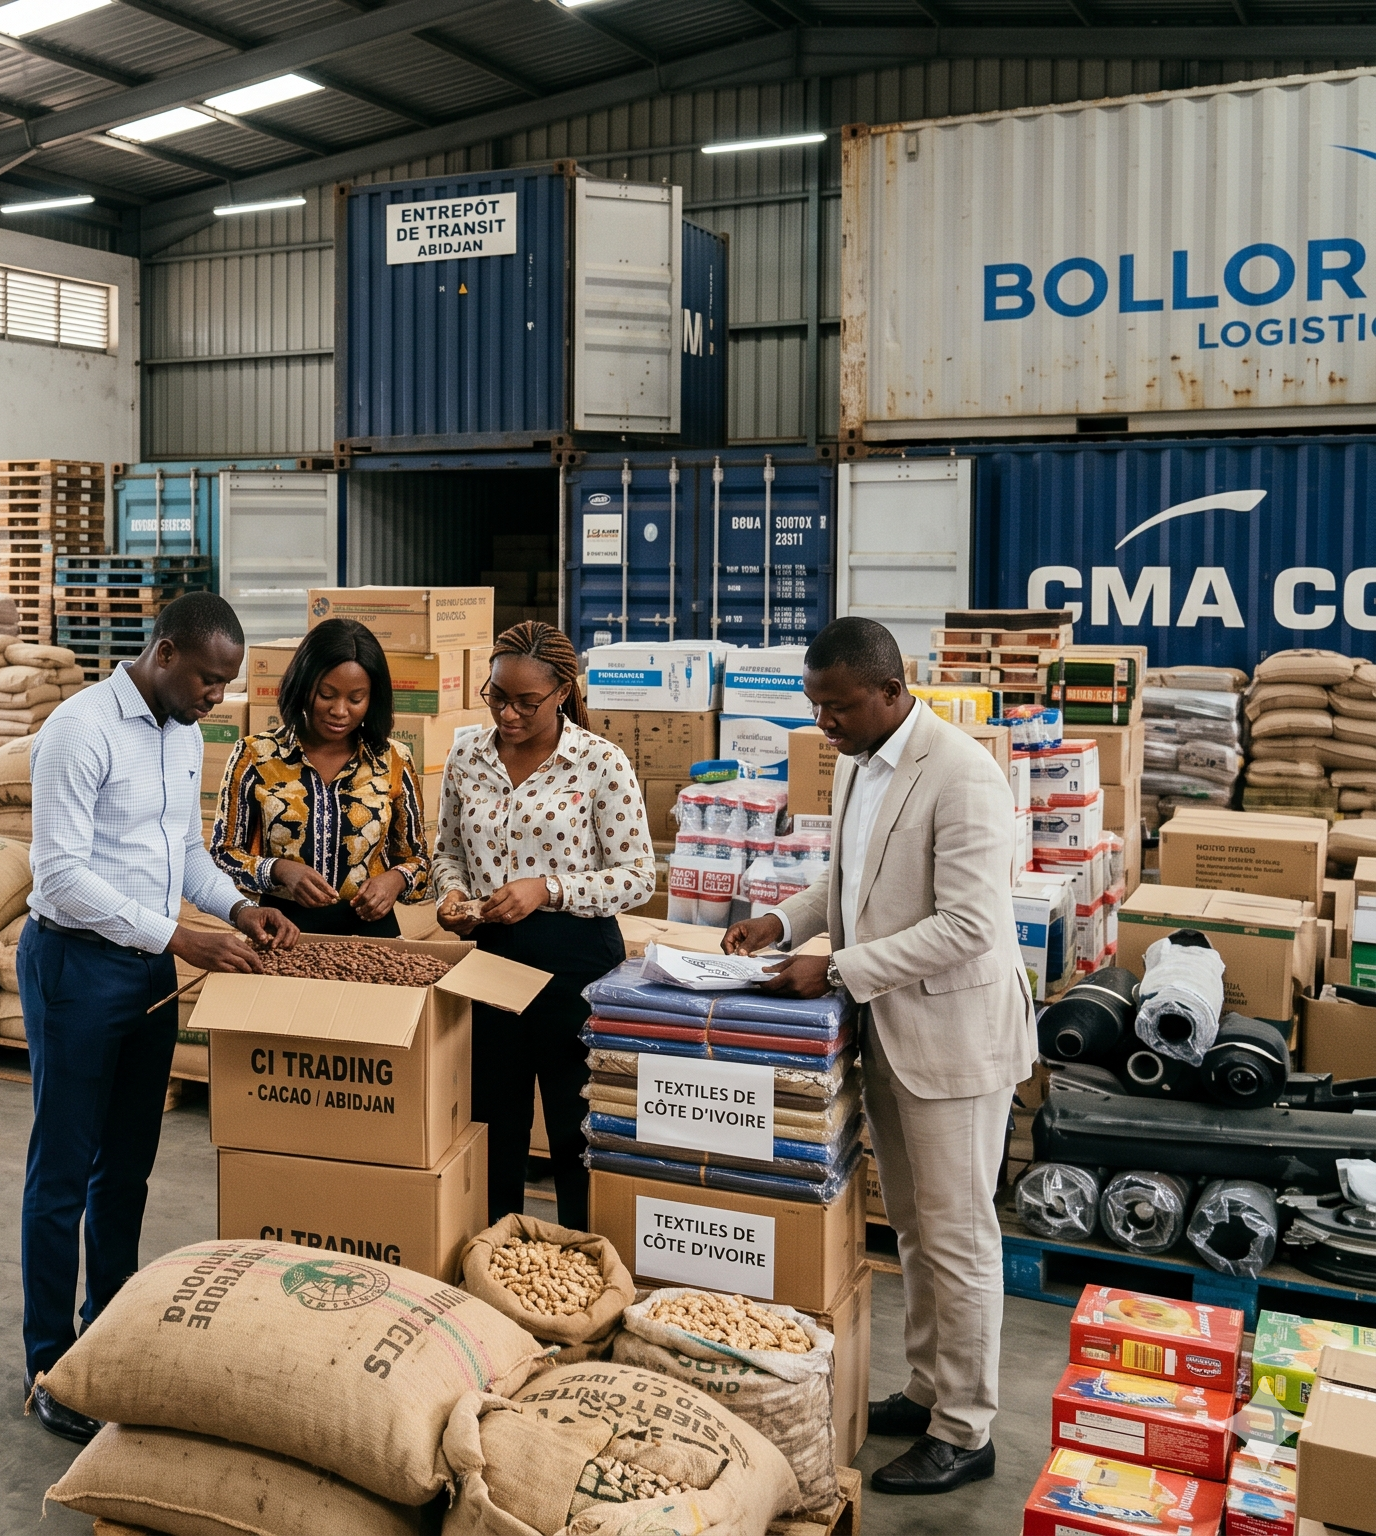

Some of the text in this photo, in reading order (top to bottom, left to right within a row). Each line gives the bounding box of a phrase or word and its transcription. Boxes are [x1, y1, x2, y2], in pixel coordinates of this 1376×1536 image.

[401, 198, 500, 223] ENTREPÔT
[396, 218, 506, 242] DE TRANSIT
[417, 239, 483, 257] ABIDJAN
[1198, 313, 1376, 349] LOGISTI
[1027, 565, 1245, 628] CMA
[251, 1048, 393, 1086] CI TRADING
[257, 1084, 312, 1106] CACAO
[324, 1090, 395, 1115] ABIDJAN
[654, 1079, 756, 1105] TEXTILES DE
[644, 1098, 766, 1129] CÔTE D'IVOIRE
[654, 1213, 756, 1243] TEXTILES DE
[291, 1230, 401, 1267] TRADING
[643, 1231, 766, 1268] CÔTE D’IVOIRE
